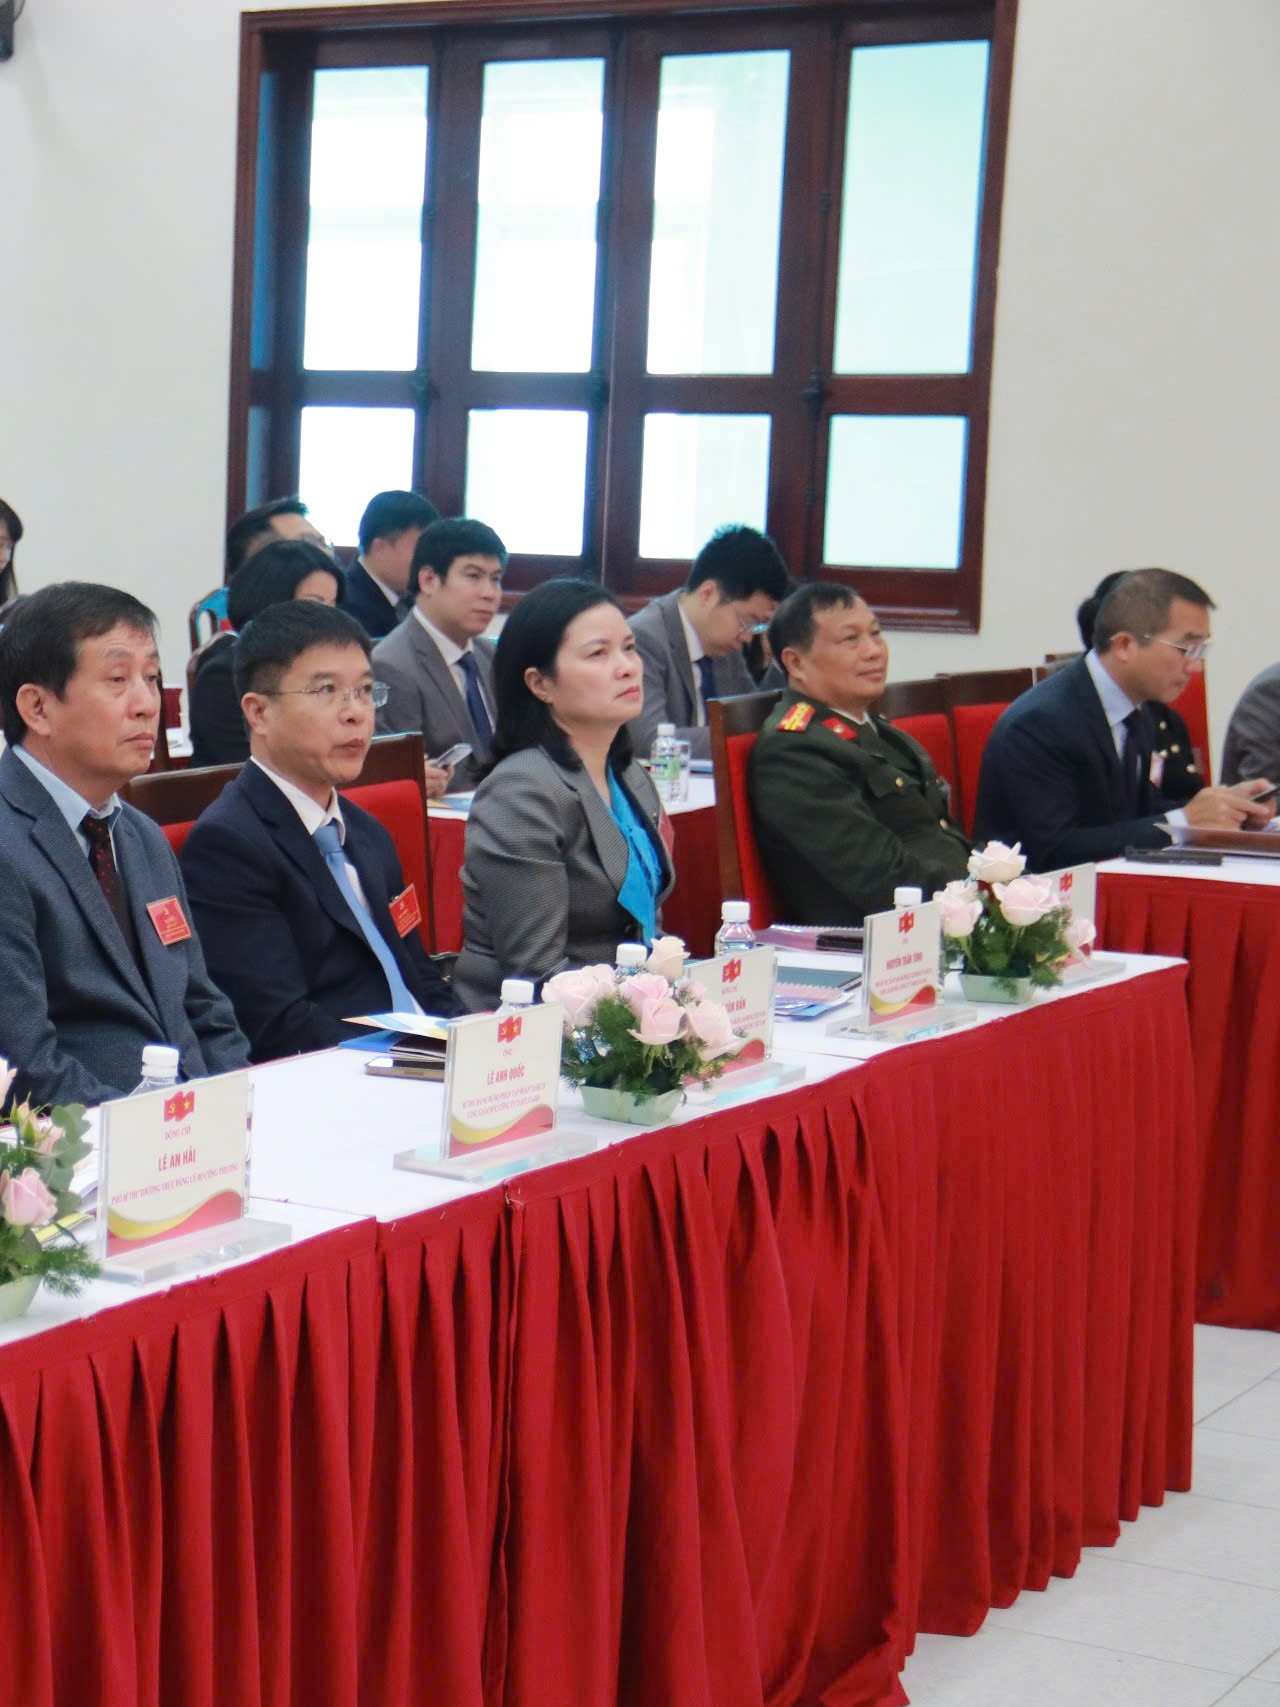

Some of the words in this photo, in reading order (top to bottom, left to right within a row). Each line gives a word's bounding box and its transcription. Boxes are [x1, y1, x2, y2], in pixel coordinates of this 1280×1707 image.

[495, 1070, 508, 1082] ANH
[158, 1152, 167, 1171] LÊ
[169, 1154, 180, 1168] AN
